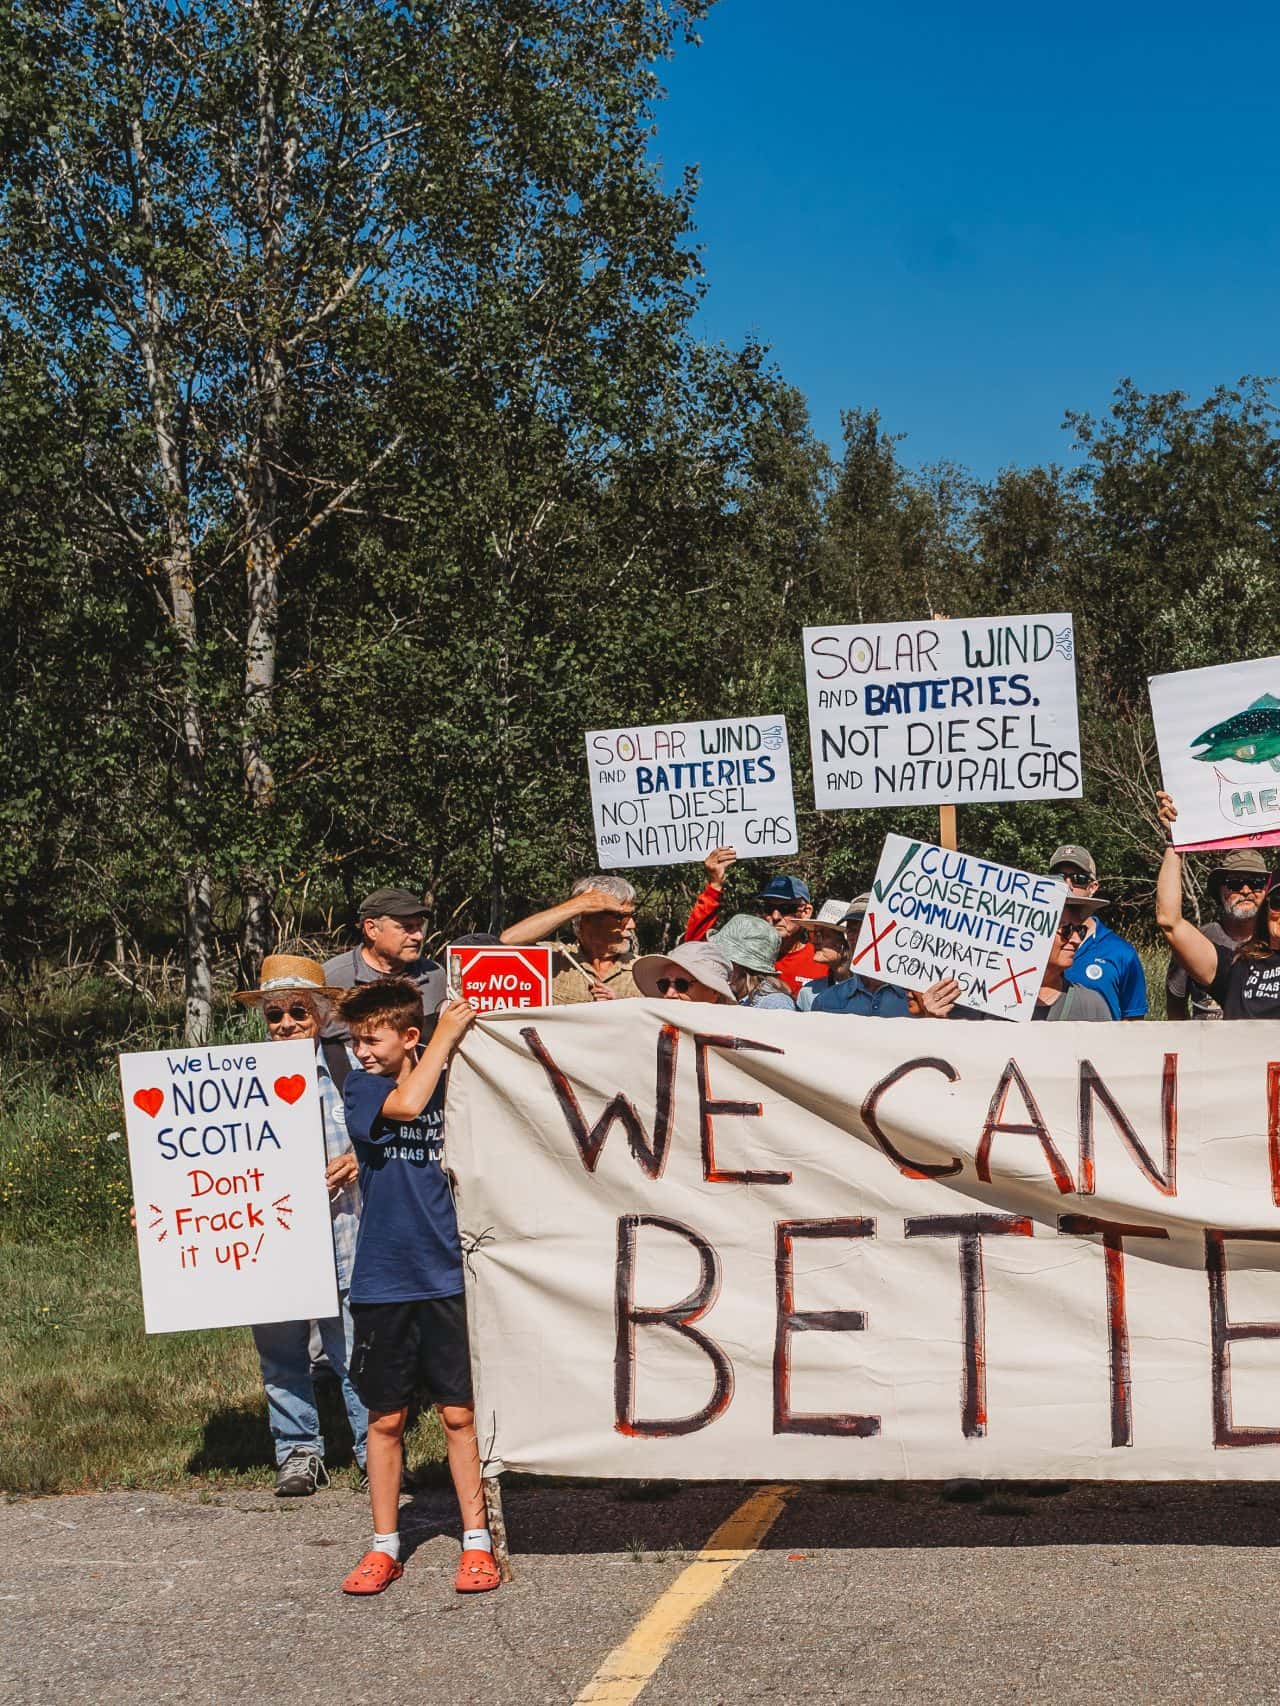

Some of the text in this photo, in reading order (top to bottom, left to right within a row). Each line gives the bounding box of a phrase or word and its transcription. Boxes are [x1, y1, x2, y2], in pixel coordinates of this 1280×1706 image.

[811, 624, 1054, 679] SOLAR WIND
[818, 674, 1040, 716] AND BATTERIES.
[593, 724, 762, 765] SOLAR WIND
[821, 715, 1052, 762] NOT DIESEL
[600, 756, 776, 794] AND BATTERIES
[827, 770, 863, 791] AND
[602, 787, 757, 827] NOT DIESEL
[600, 834, 621, 846] AND
[745, 816, 792, 845] GAS
[921, 847, 1056, 904] CULTURE
[888, 892, 1035, 952] COMMUNITIES
[900, 871, 1058, 938] CONSERVATION
[895, 926, 1003, 970] CORPORATE
[466, 974, 532, 992] say NO to
[886, 954, 988, 1003] CRONYISM
[468, 996, 531, 1010] SHALE
[168, 1052, 258, 1077] We Love
[171, 1076, 270, 1117] NOVA
[518, 1022, 793, 1187] WE
[859, 1052, 1179, 1199] CAN
[156, 1119, 281, 1161] SCOTIA
[400, 1125, 422, 1140] GAS
[400, 1147, 424, 1160] GAS
[187, 1167, 265, 1197] Don't
[175, 1202, 265, 1236] Frack
[180, 1234, 265, 1270] it up!
